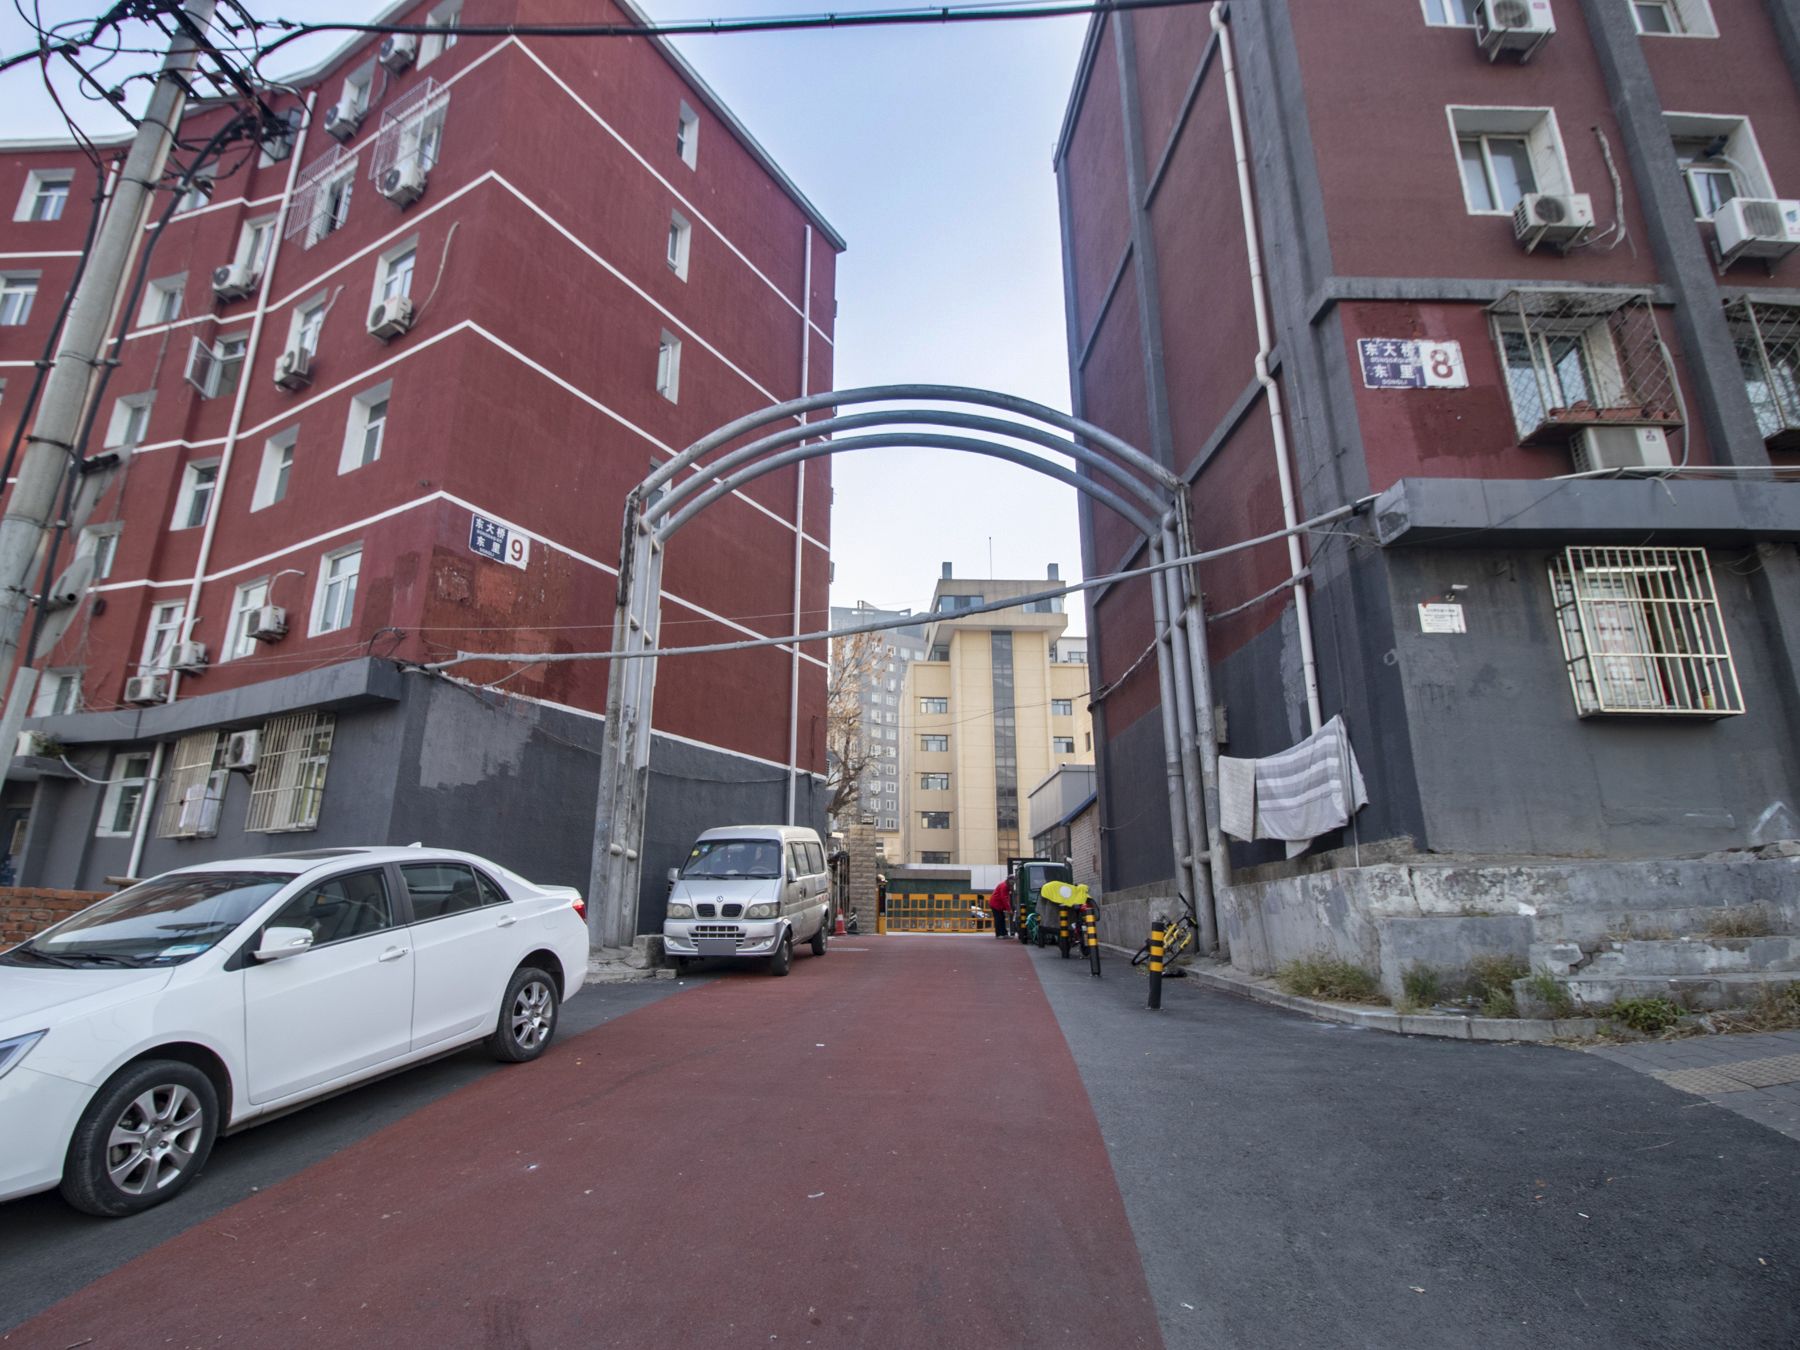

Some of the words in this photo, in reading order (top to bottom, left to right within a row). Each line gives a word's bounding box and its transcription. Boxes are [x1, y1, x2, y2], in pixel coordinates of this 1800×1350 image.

[1373, 364, 1416, 379] 东里
[1430, 349, 1453, 379] 8
[475, 518, 506, 540] 东大桥
[476, 536, 501, 555] 东里
[511, 538, 524, 562] 9
